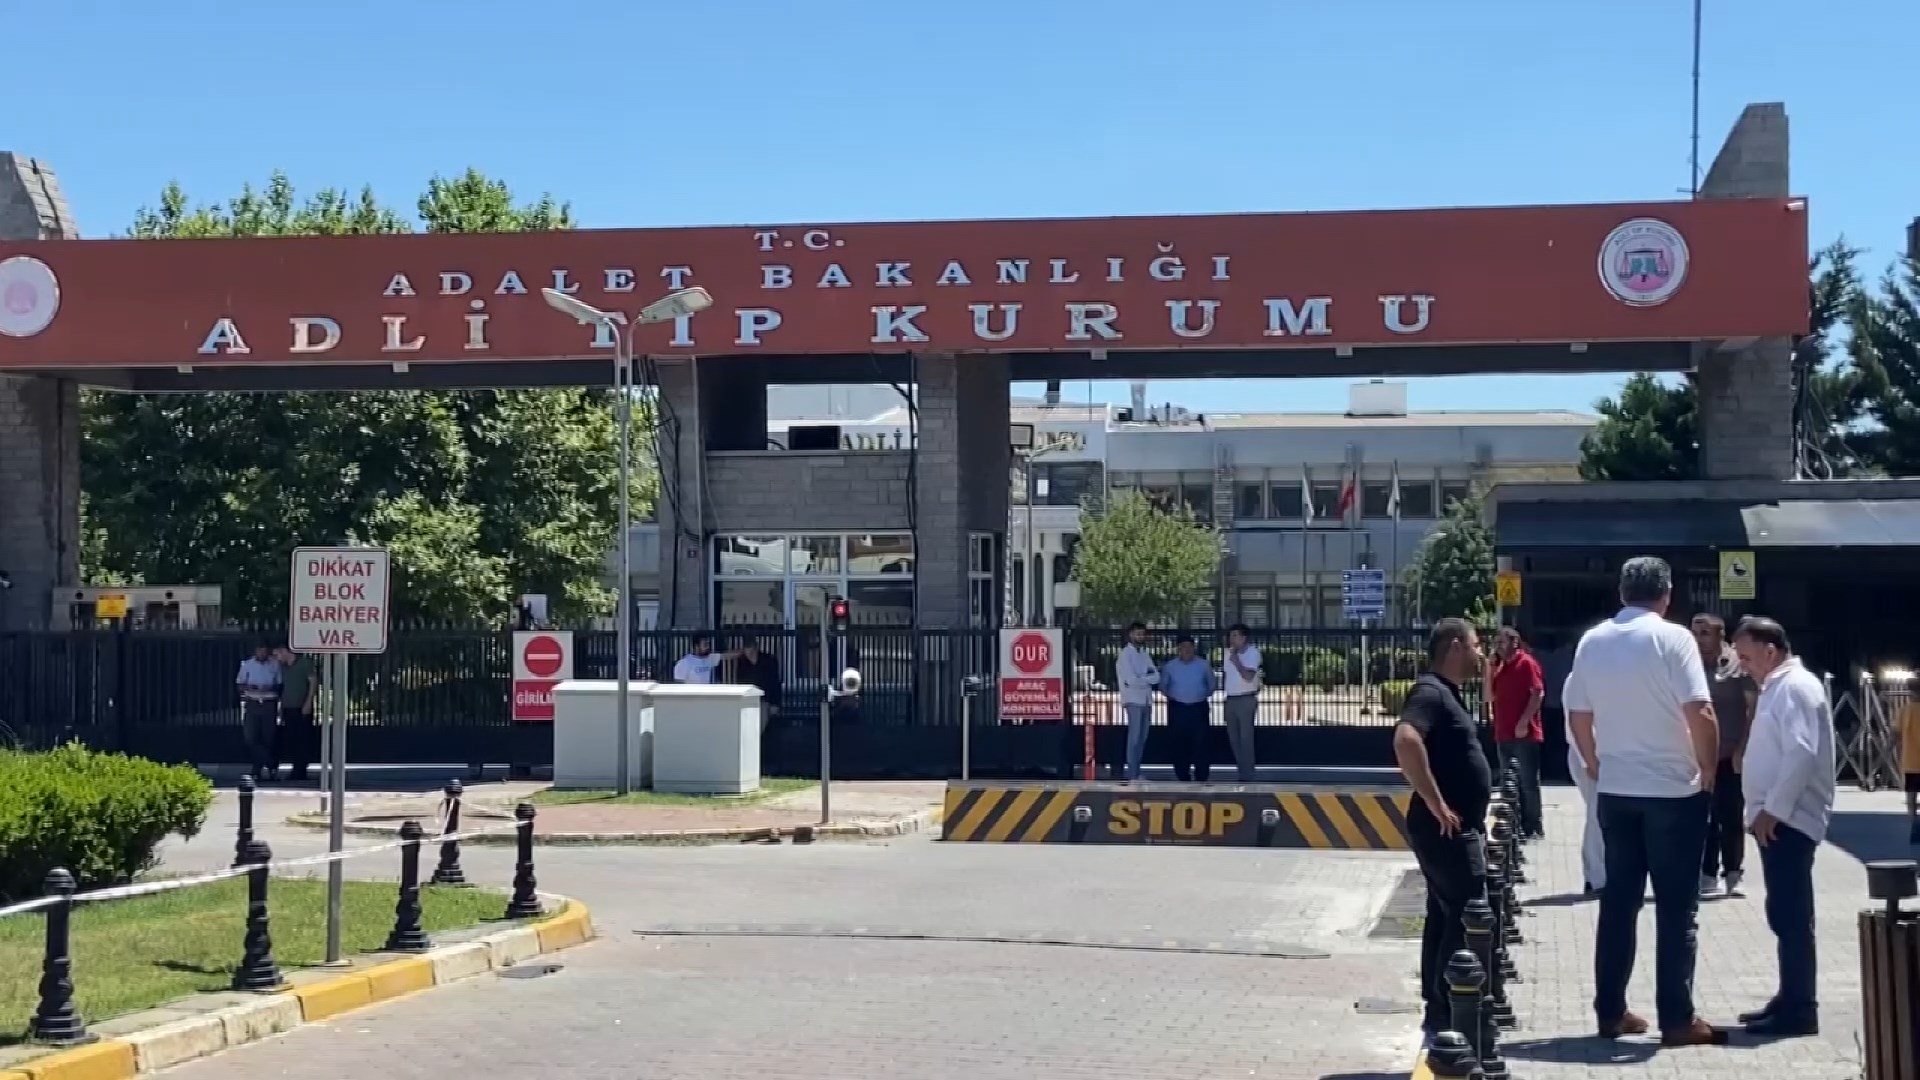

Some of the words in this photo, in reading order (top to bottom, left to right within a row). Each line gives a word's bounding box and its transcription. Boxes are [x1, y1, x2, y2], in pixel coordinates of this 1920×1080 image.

[753, 230, 845, 251] T.C.
[383, 265, 693, 296] ADALET
[760, 242, 1231, 289] BAKANLIĞI
[198, 299, 490, 354] ADLİ
[589, 307, 782, 348] TIP
[871, 294, 1436, 345] KURUMU
[314, 583, 365, 600] BLOK
[299, 602, 380, 623] BARİYER
[318, 629, 359, 646] VAR.
[1014, 646, 1048, 661] DUR
[1108, 801, 1244, 835] STOP
